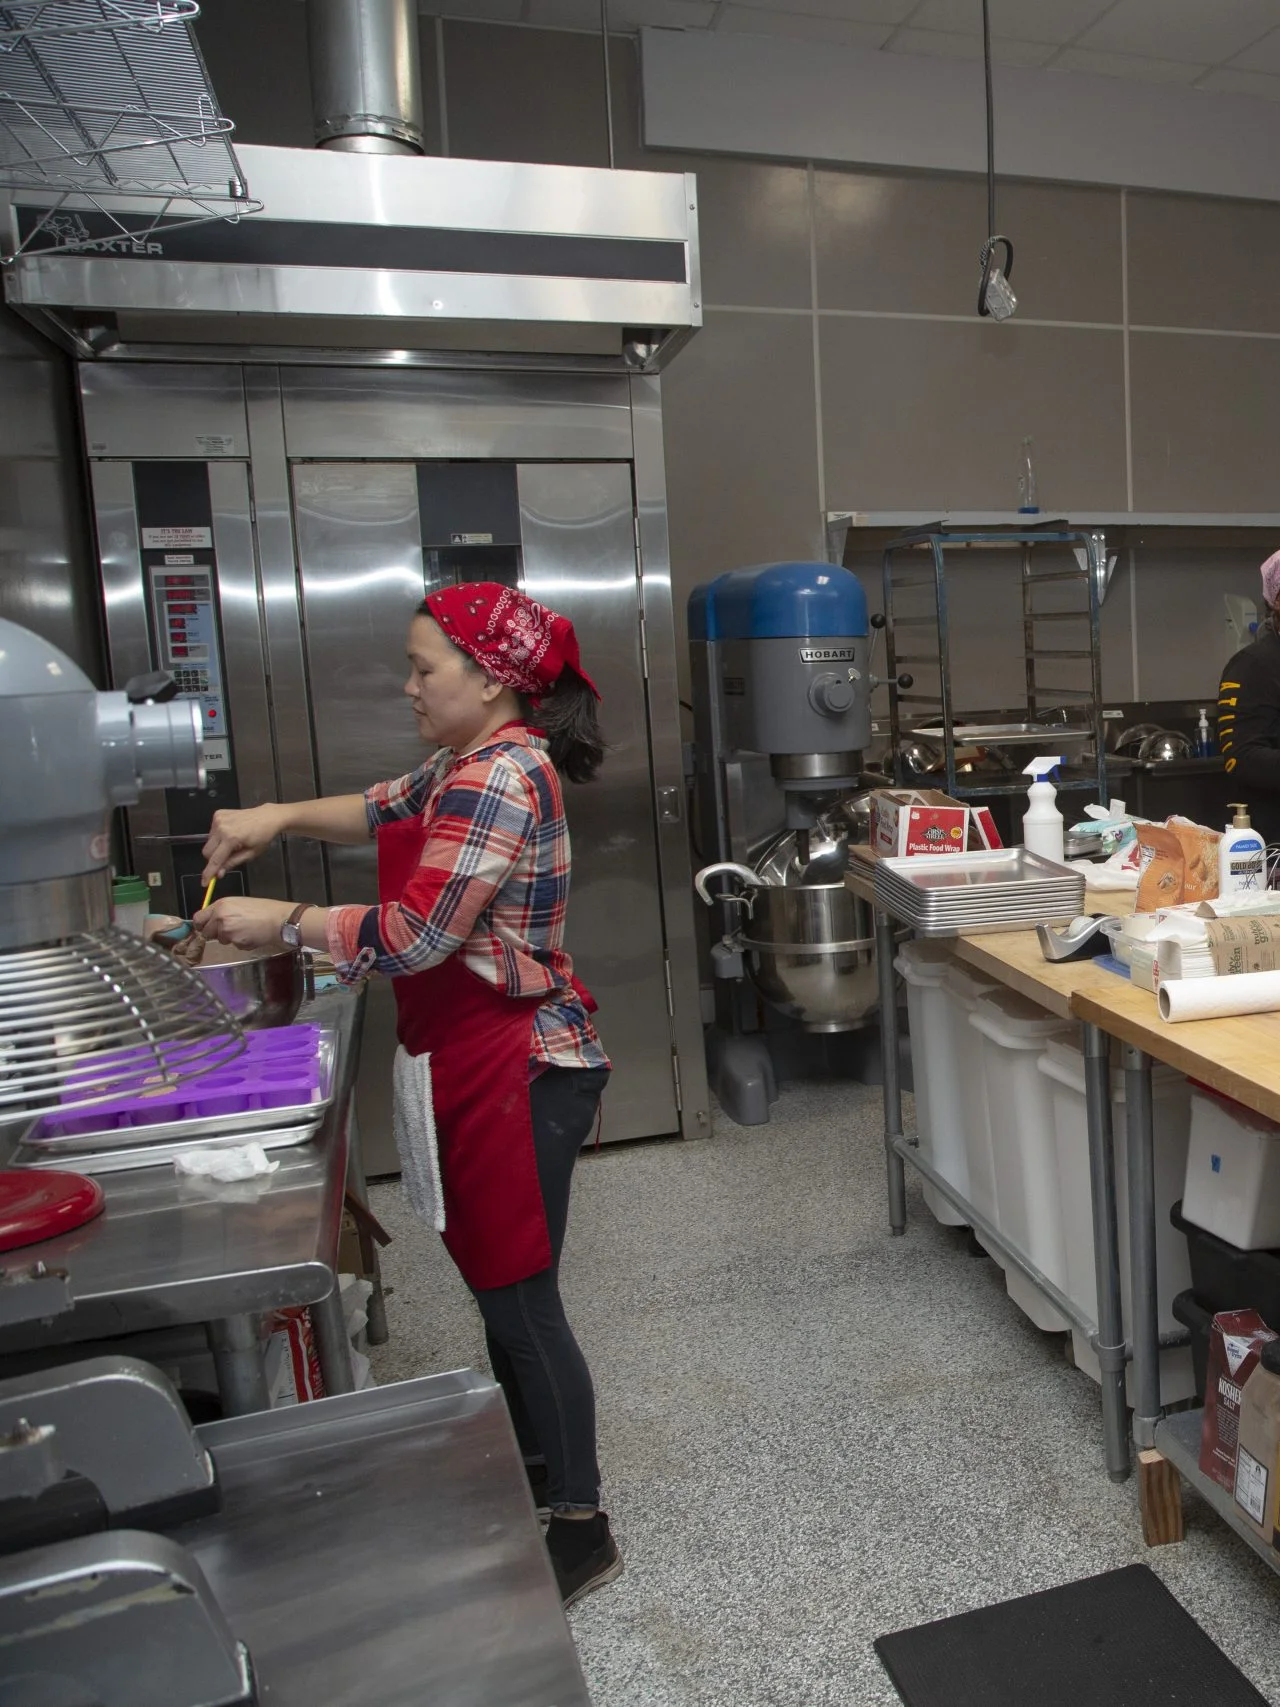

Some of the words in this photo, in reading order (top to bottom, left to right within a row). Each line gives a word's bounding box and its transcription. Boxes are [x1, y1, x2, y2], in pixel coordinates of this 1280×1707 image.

[805, 650, 852, 659] HOBART
[909, 842, 929, 851] Plastic
[929, 843, 944, 851] Food
[944, 844, 961, 853] Wrap
[1230, 862, 1247, 870] GOLD
[1223, 1396, 1236, 1411] SALT
